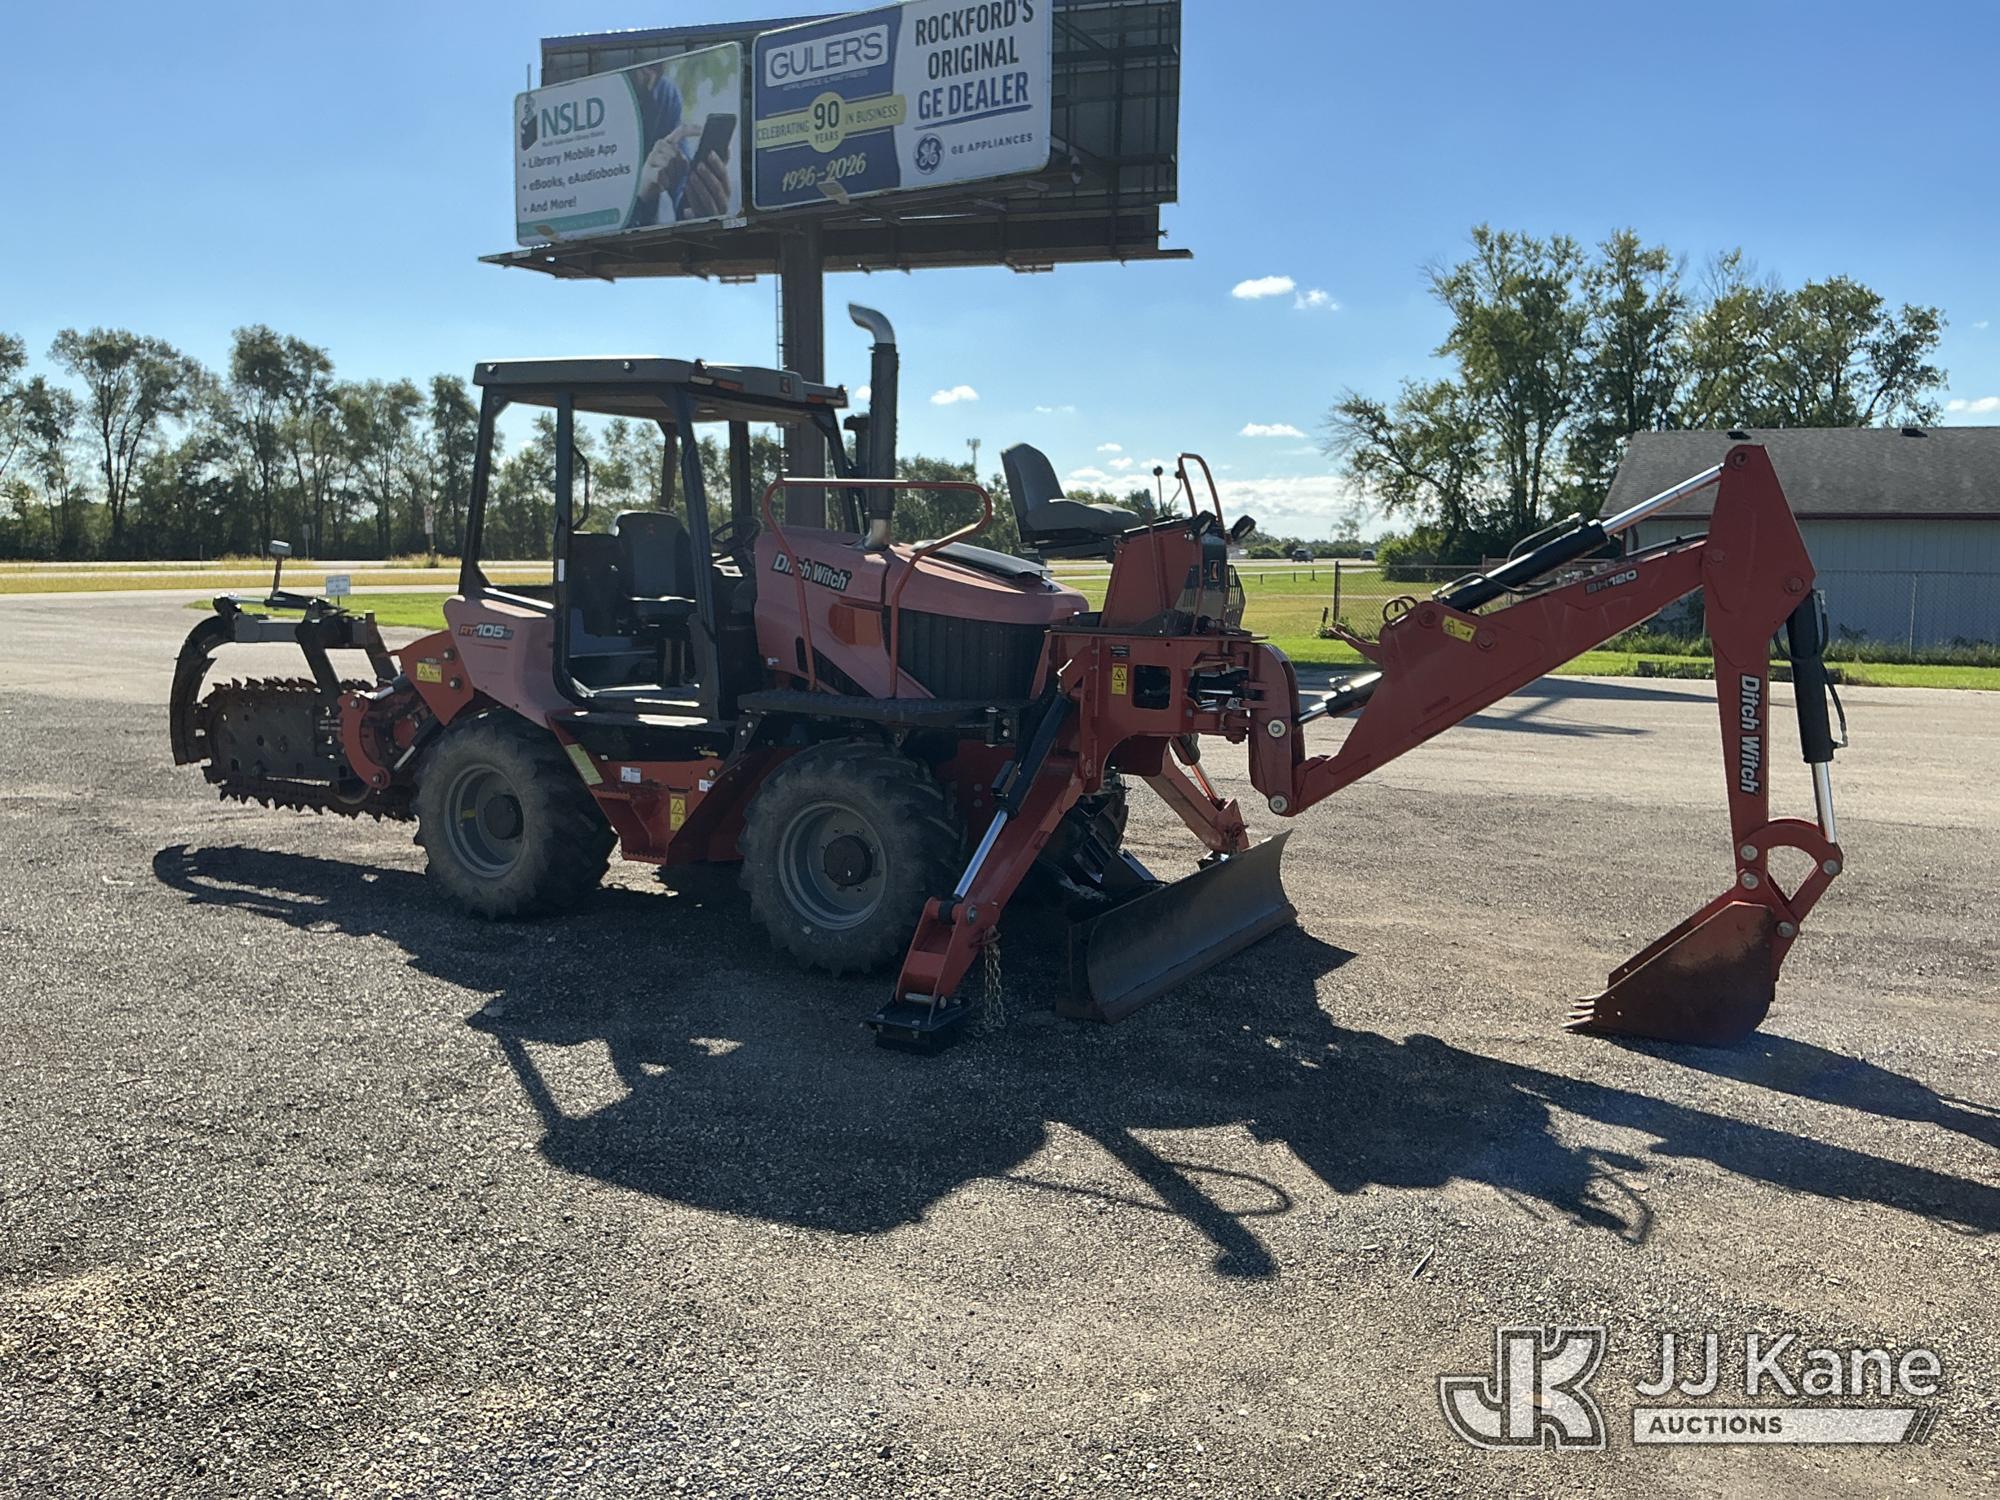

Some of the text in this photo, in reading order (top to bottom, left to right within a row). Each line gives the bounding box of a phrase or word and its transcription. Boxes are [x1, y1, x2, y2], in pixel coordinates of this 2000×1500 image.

[915, 0, 1034, 46] ROCKFORD'S
[770, 32, 882, 79] GULER'S
[928, 36, 1019, 80] ORIGINAL
[918, 71, 1029, 120] GE DEALER
[541, 97, 605, 138] NSLD
[814, 100, 840, 130] 90
[856, 104, 899, 123] BUSINESS
[757, 120, 810, 141] CELEBRATING
[814, 130, 840, 144] YEARS
[951, 133, 1033, 155] GE APPLIANCES
[528, 143, 618, 168] Library Mobile App
[529, 164, 631, 191] eBooks, eAudiobooks
[530, 196, 577, 213] And More!
[812, 561, 847, 591] Witch
[1740, 674, 1761, 794] Ditch Witch
